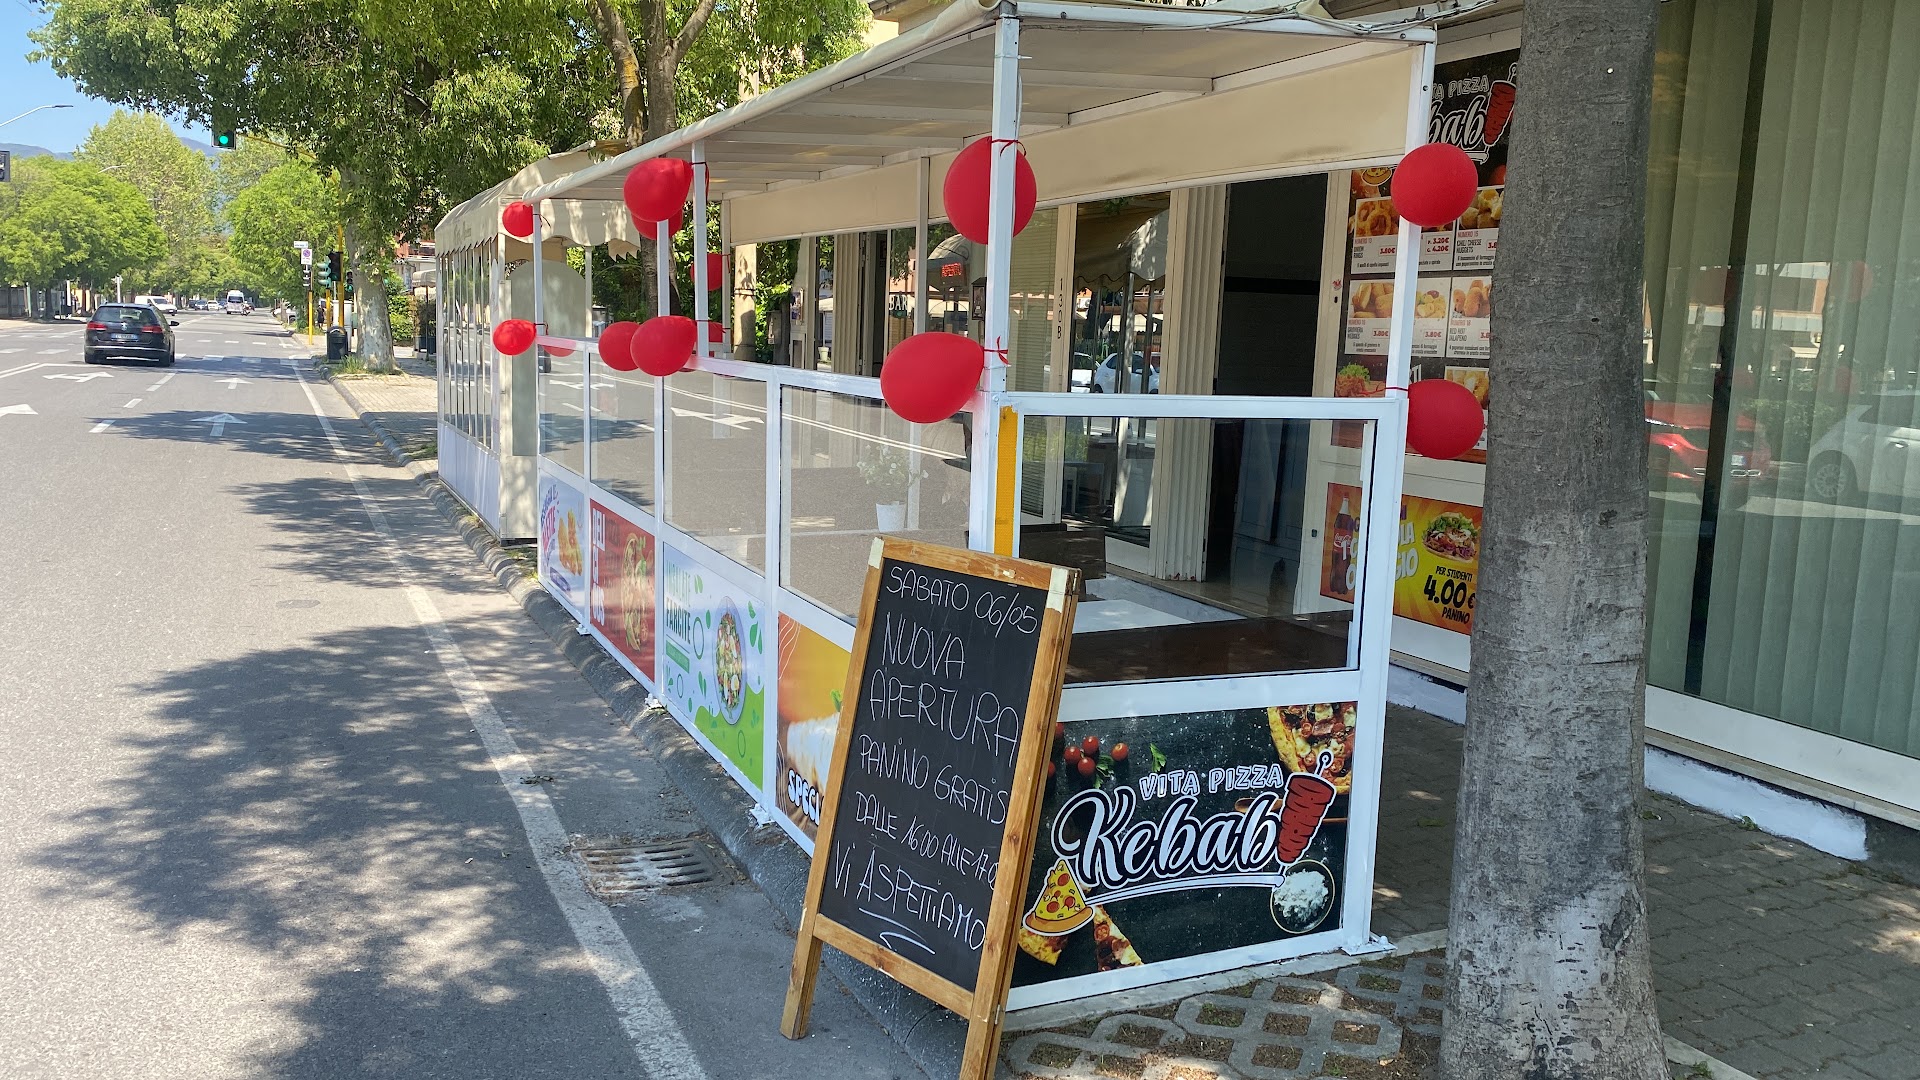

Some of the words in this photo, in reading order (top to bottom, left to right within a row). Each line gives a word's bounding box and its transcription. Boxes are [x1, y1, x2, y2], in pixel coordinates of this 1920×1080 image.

[1448, 75, 1490, 98] PIZZA
[1433, 237, 1450, 245] 3.20€
[889, 294, 907, 311] BAR
[1436, 565, 1447, 576] PER
[1446, 568, 1473, 583] STUDENTI
[666, 597, 691, 645] FARCITE
[886, 566, 970, 611] SABATO
[975, 592, 1038, 638] 06/05
[1441, 606, 1471, 625] PANINO
[882, 611, 966, 680] NUOVA
[869, 669, 1019, 768] APERTURA
[788, 768, 824, 827] SPECI
[1139, 770, 1200, 800] VITA
[1208, 763, 1284, 794] PIZZA
[856, 791, 898, 840] DALLE
[1051, 786, 1282, 889] Kebab
